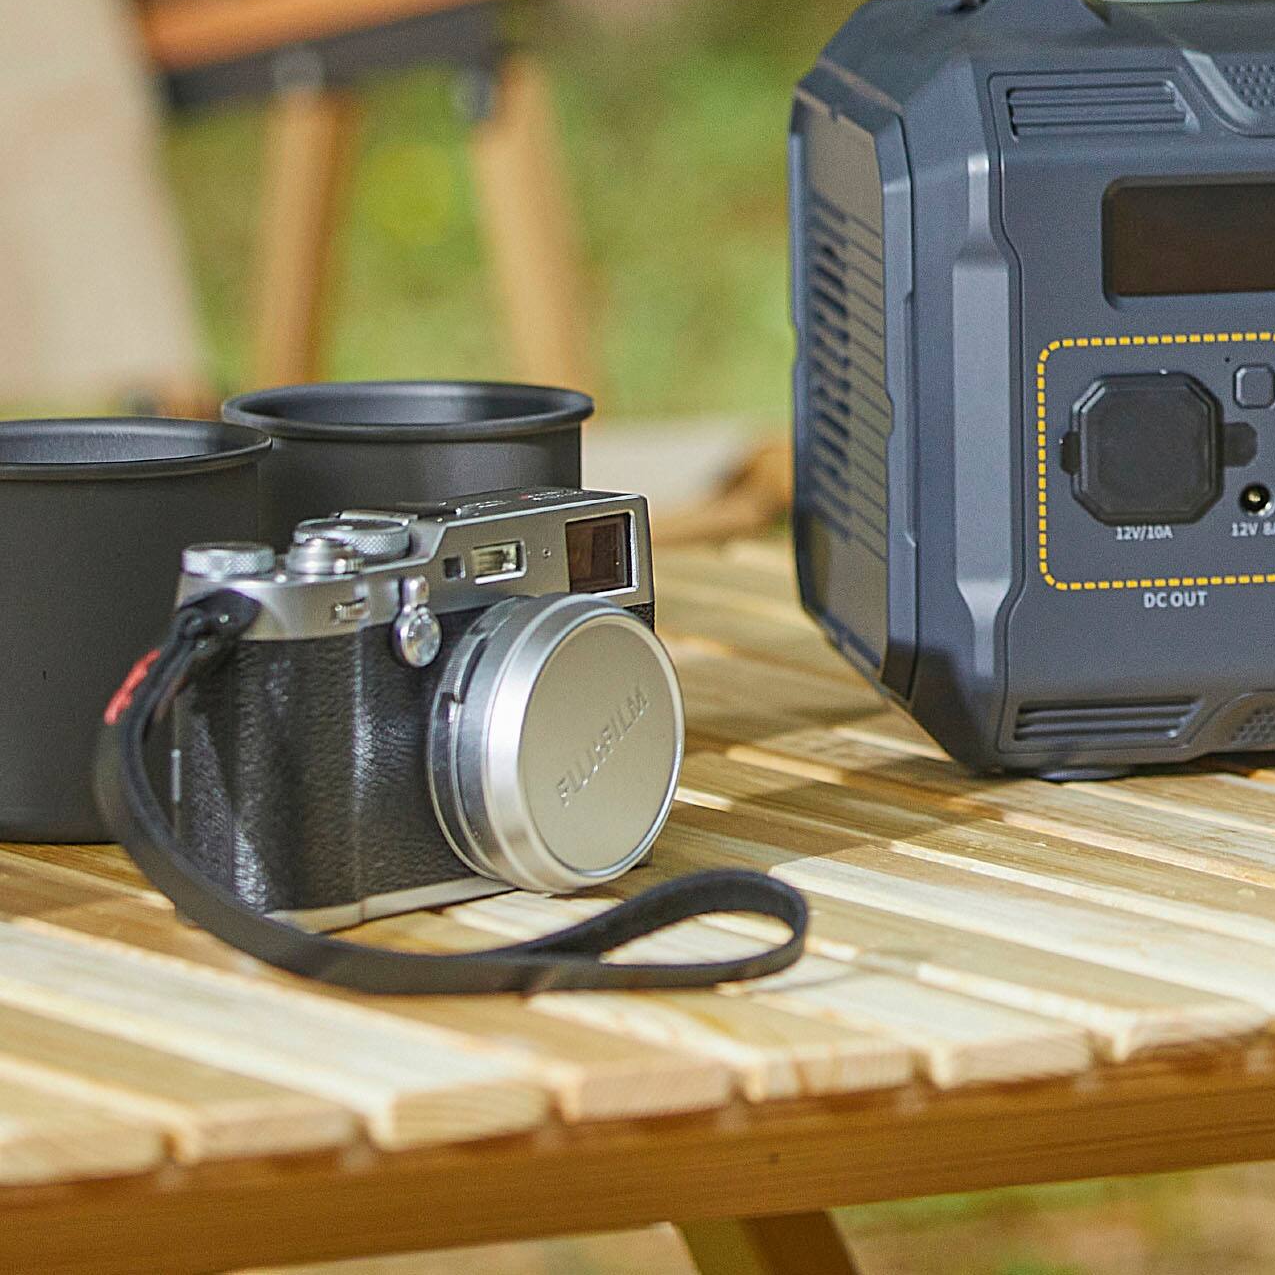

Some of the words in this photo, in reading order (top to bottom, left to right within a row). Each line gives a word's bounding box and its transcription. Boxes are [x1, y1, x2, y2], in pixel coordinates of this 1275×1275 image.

[1115, 525, 1173, 541] 12V/10A
[1231, 522, 1257, 537] 12V
[1143, 591, 1167, 608] DC
[1169, 590, 1208, 607] OUT
